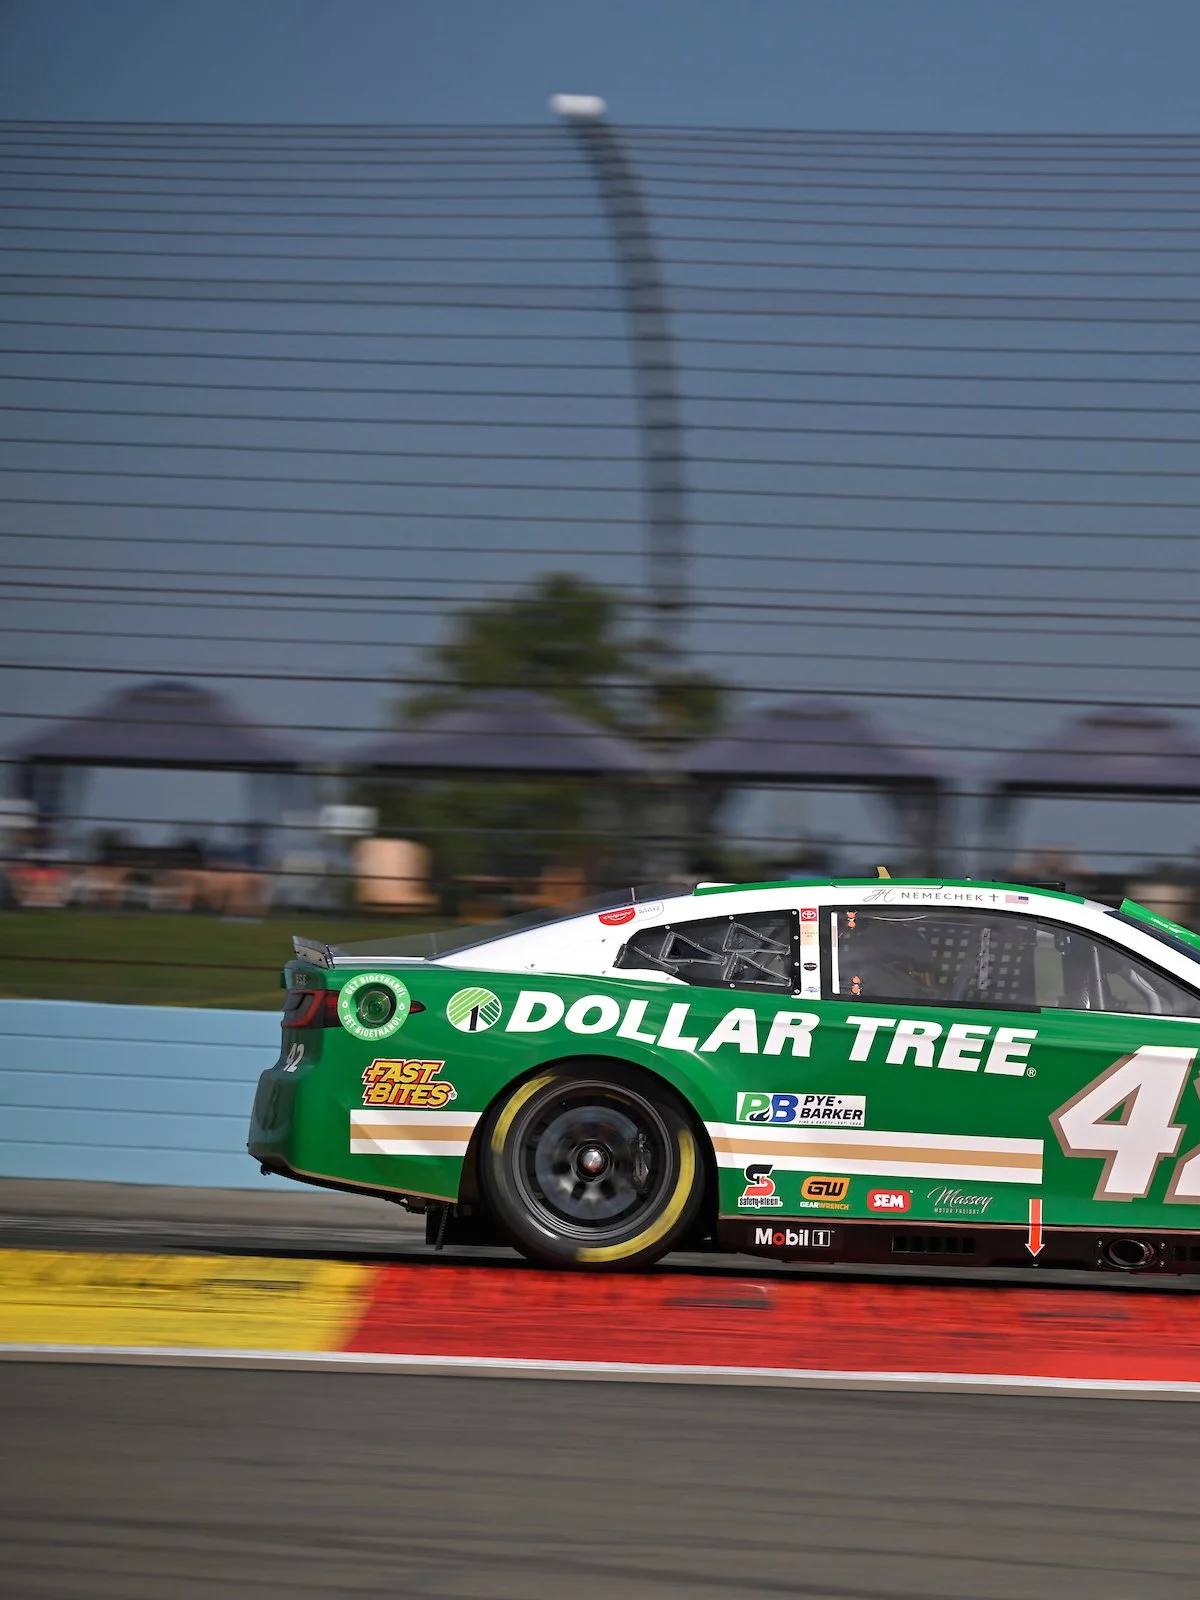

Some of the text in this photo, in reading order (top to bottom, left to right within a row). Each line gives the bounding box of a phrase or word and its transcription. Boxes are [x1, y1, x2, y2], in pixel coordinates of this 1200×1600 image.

[901, 892, 983, 901] NEMECHEK
[345, 975, 407, 998] GET BIOETHANOL
[344, 1014, 401, 1038] GET BIOETHANOL
[505, 990, 1038, 1077] DOLLAR TREE
[283, 1043, 304, 1072] 42
[367, 1061, 440, 1083] FAST
[367, 1083, 451, 1106] BITES
[804, 1095, 835, 1106] PYE
[800, 1108, 863, 1120] BARKER
[739, 1197, 779, 1207] safety-kleen
[800, 1201, 849, 1210] GEARWRENCH
[873, 1194, 904, 1208] SEM
[927, 1186, 993, 1213] Massey
[755, 1228, 809, 1246] Mobil
